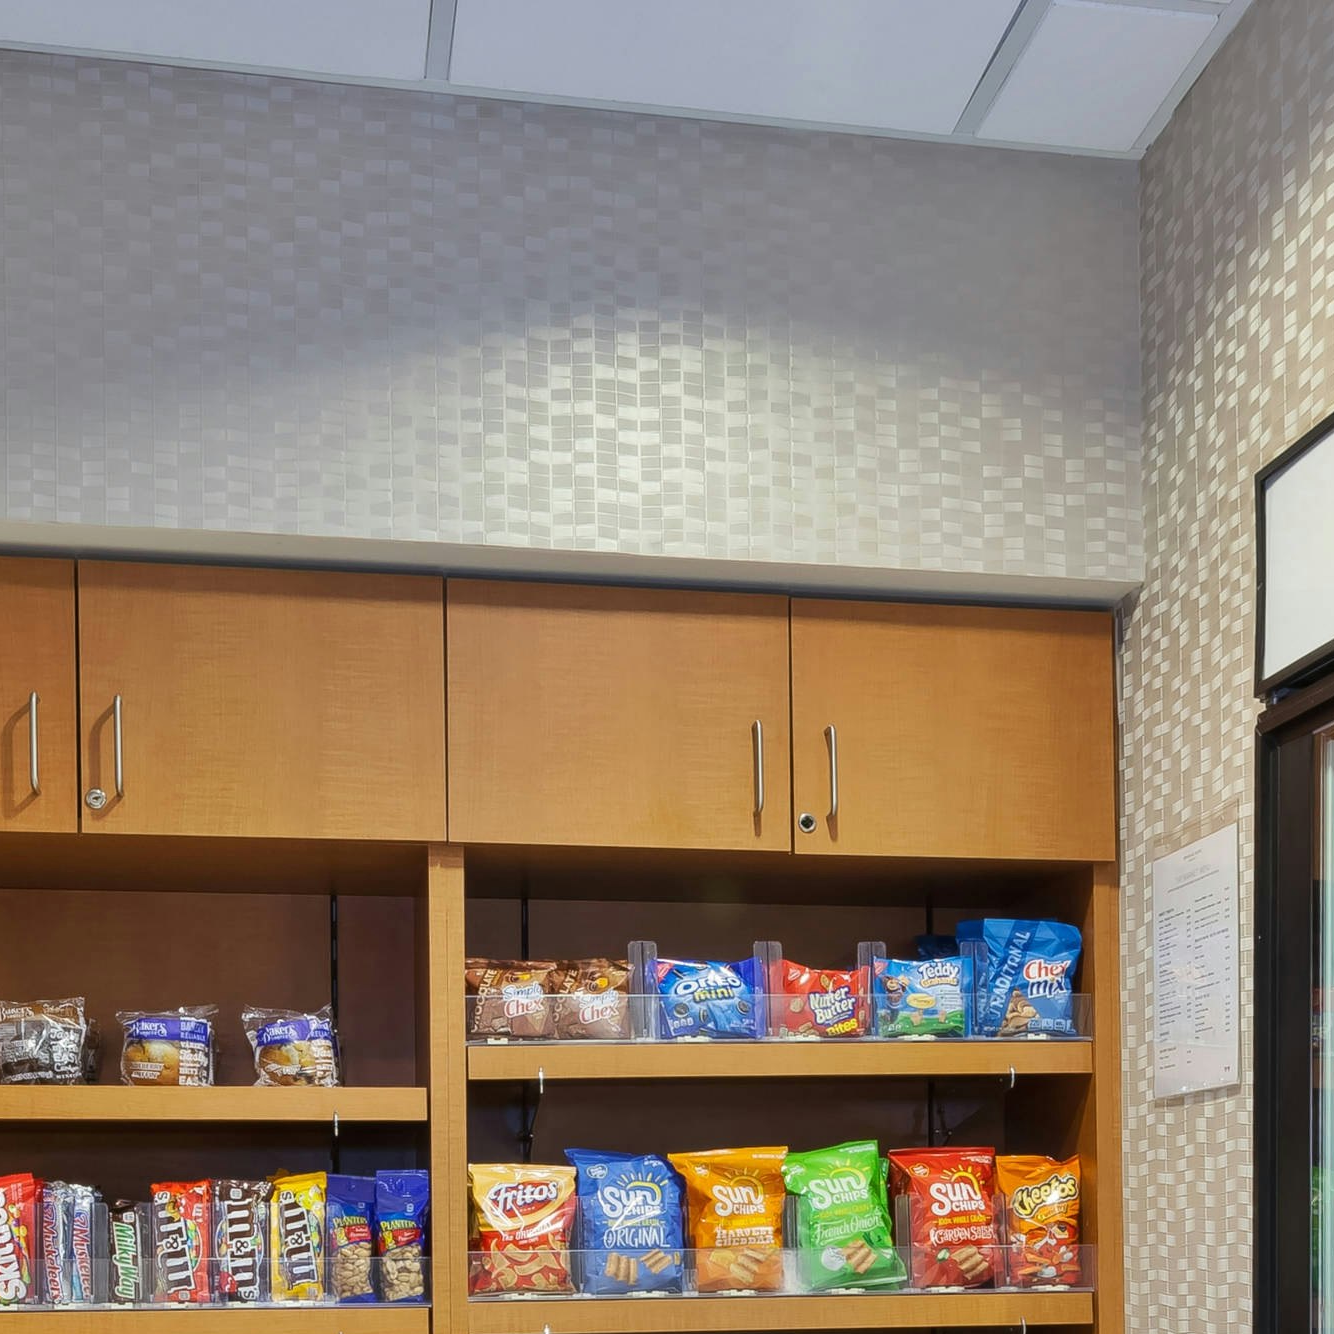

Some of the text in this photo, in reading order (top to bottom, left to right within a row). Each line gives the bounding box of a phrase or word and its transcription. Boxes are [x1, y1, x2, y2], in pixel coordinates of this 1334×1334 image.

[919, 961, 960, 979] Teddy
[1023, 959, 1071, 981] Chex
[675, 969, 741, 994] OREO
[1028, 976, 1067, 998] mix
[692, 986, 734, 1003] mini
[810, 986, 849, 1009] Nutter
[504, 998, 544, 1018] Chex
[580, 1002, 618, 1024] Chex
[815, 997, 855, 1023] Butter
[825, 1018, 858, 1037] Bites
[489, 1182, 558, 1214] Fritos
[603, 1186, 661, 1218] Sun
[712, 1185, 764, 1216] Sun
[809, 1178, 866, 1210] Sun
[830, 1189, 867, 1205] CHIPS
[930, 1182, 982, 1216] Sun
[1014, 1178, 1076, 1214] Cheetos
[733, 1203, 766, 1215] CHIPS
[951, 1201, 986, 1212] CHIPS
